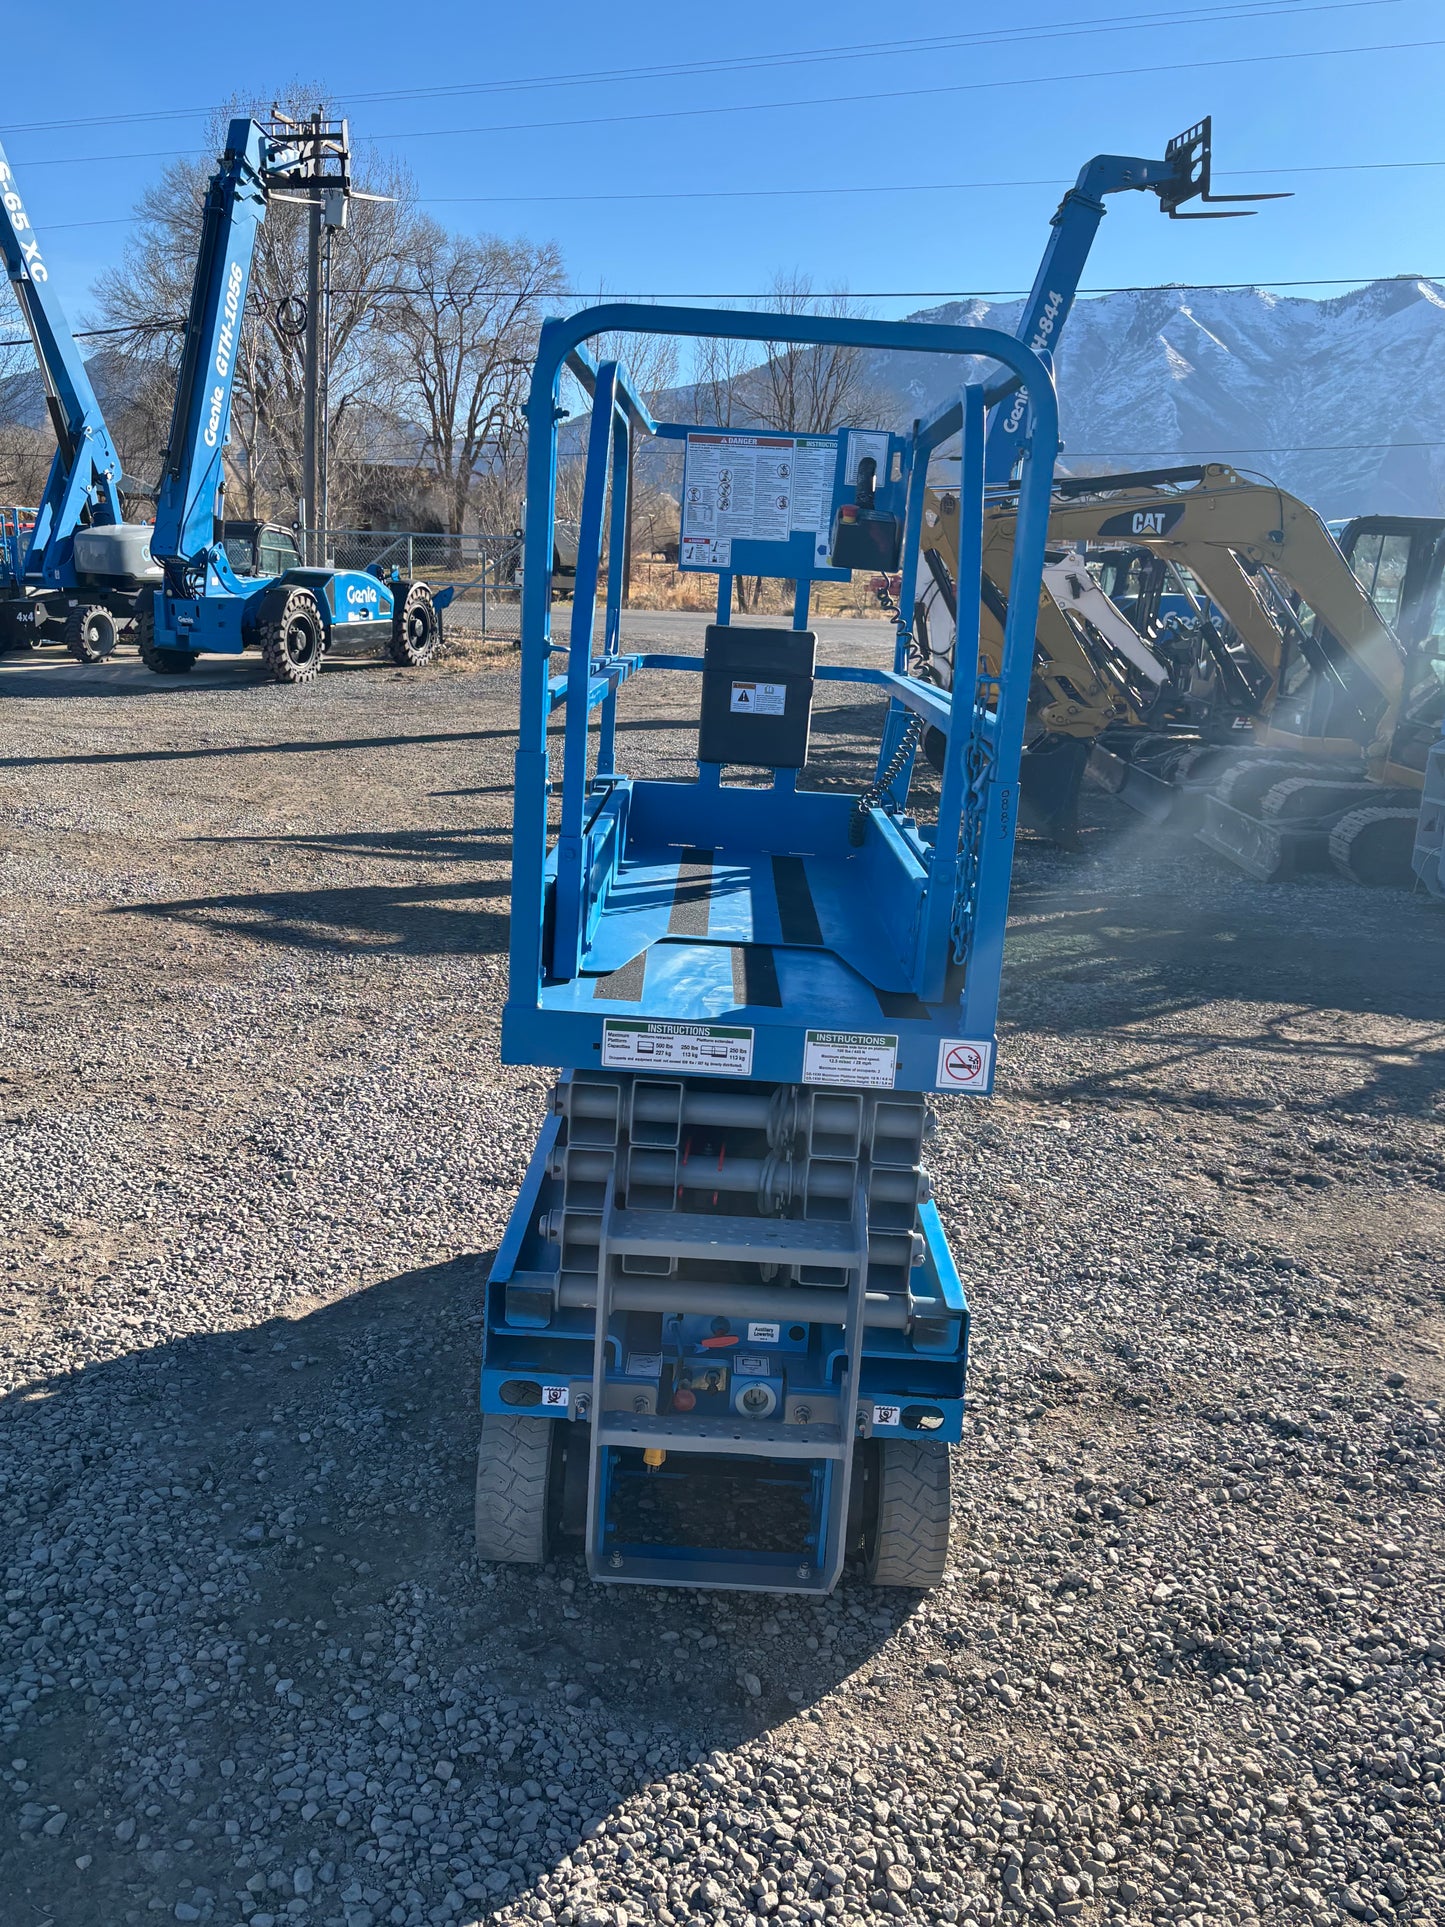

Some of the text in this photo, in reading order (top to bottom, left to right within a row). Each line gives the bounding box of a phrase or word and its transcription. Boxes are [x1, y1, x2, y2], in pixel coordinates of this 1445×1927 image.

[20, 239, 48, 283] XC
[203, 262, 243, 447] Genie GTH-1056
[728, 437, 758, 445] DANGER
[1132, 512, 1166, 534] CAT
[346, 585, 377, 604] Genie
[16, 612, 34, 622] 4x4
[647, 1024, 711, 1036] INSTRUCTIONS
[816, 1033, 886, 1045] INSTRUCTIONS
